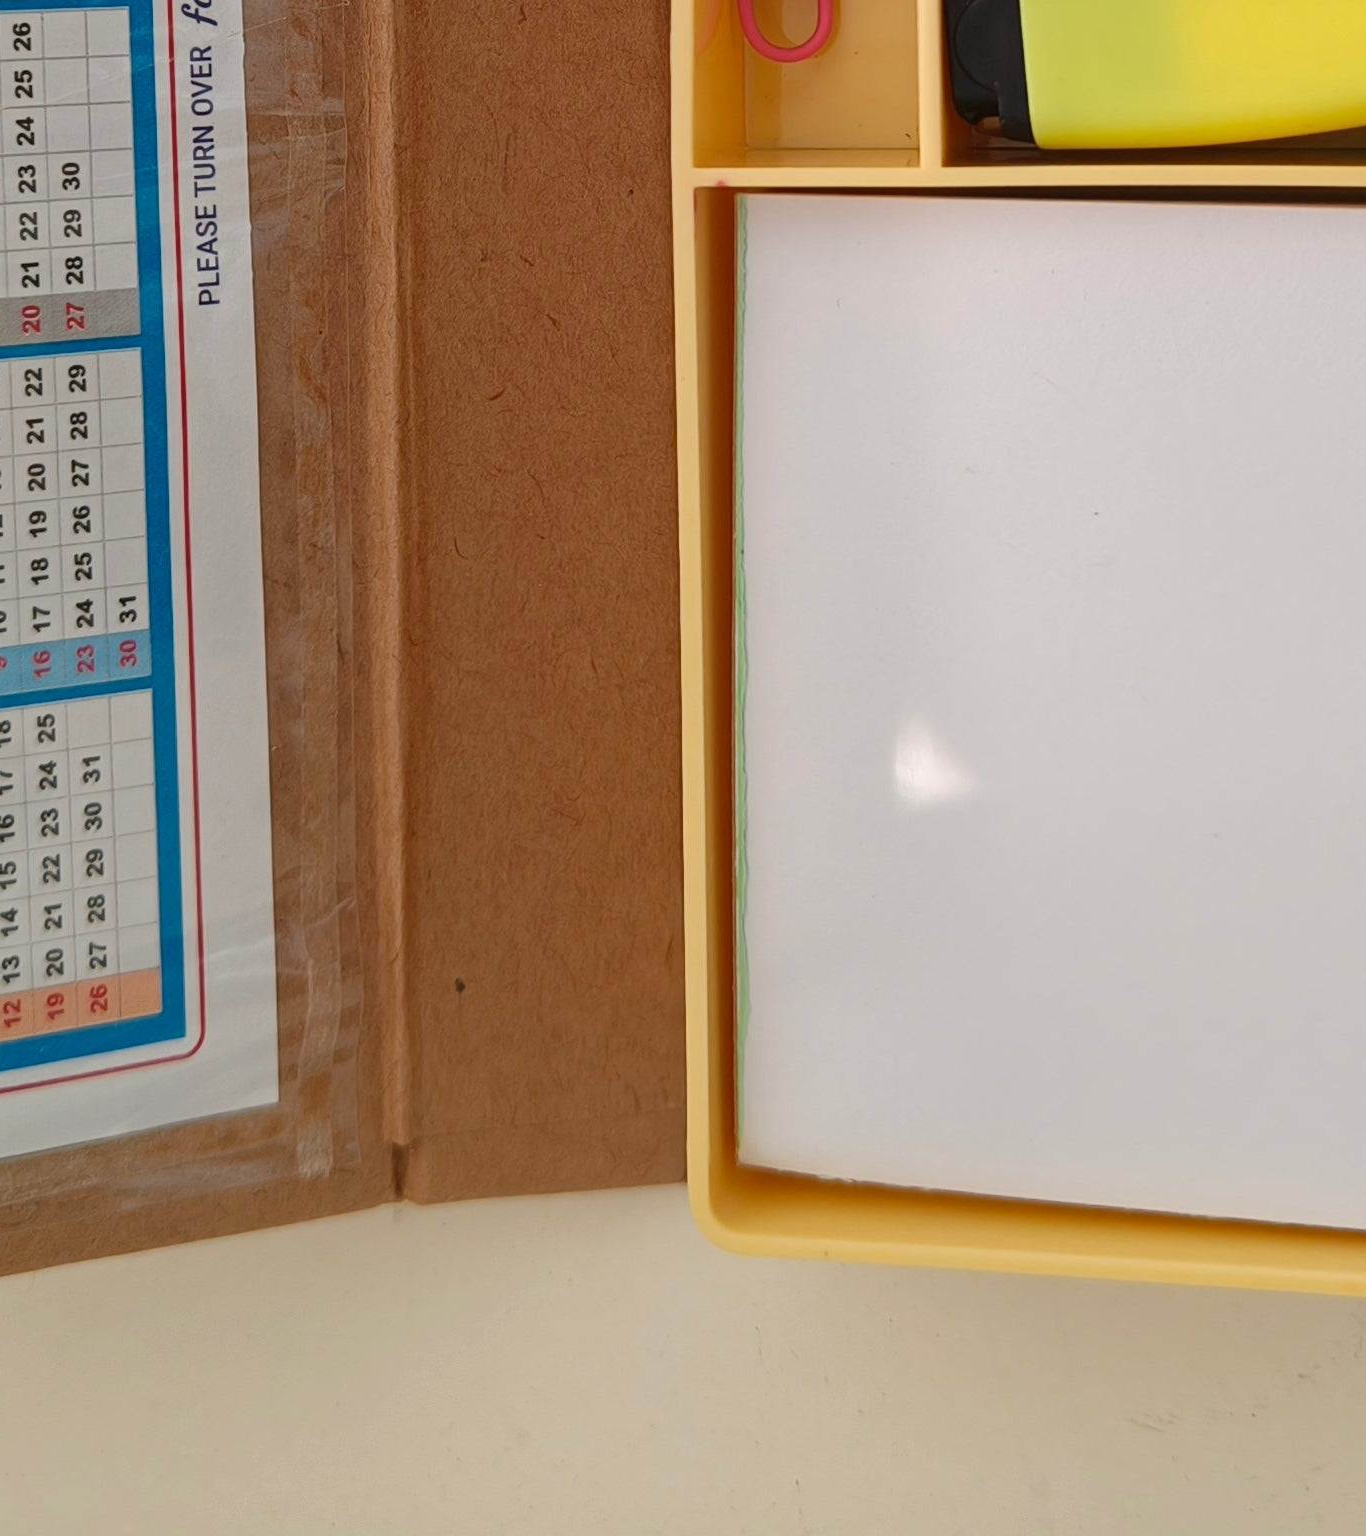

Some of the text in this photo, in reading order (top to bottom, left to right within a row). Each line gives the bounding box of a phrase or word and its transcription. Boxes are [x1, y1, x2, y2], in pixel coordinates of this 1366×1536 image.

[189, 45, 215, 117] OVER
[11, 21, 43, 335] 20 21 22 23 24 25 26
[192, 123, 217, 198] TURN
[194, 203, 221, 307] PLEASE
[35, 712, 66, 1022] 19 20 21 22 23 24 25
